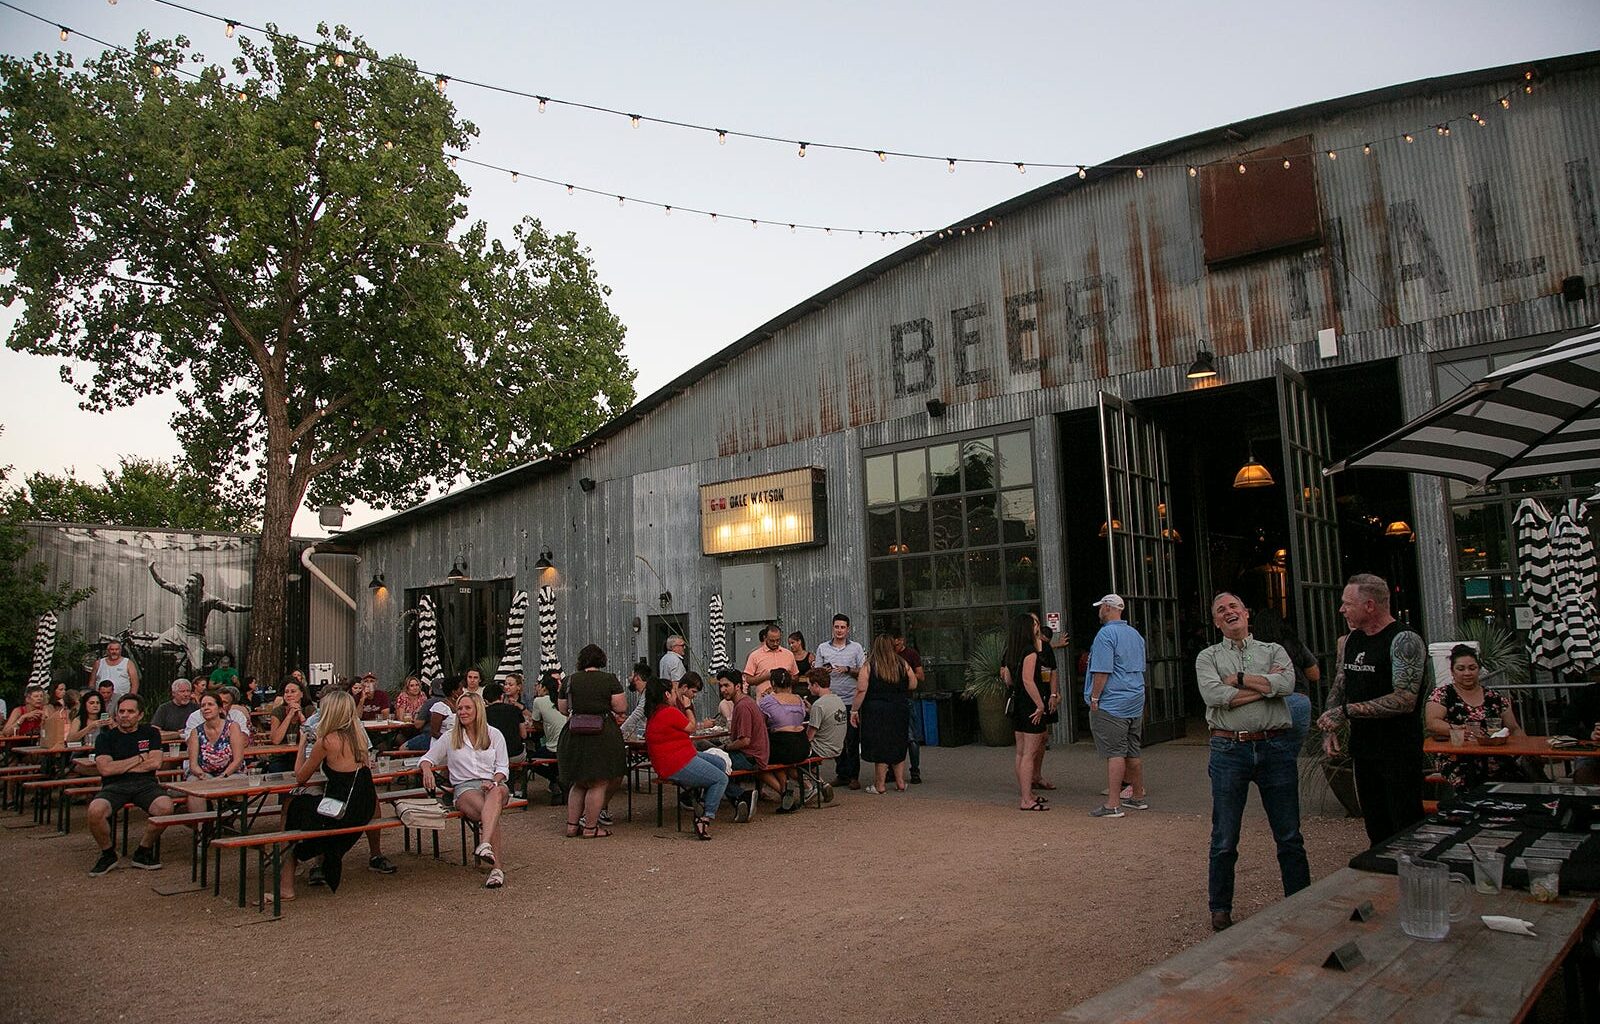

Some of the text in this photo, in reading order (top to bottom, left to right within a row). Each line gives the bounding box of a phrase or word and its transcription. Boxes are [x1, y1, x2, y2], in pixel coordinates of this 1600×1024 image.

[890, 272, 1122, 399] BEER
[729, 493, 748, 509] DALE
[750, 487, 785, 505] WATSON
